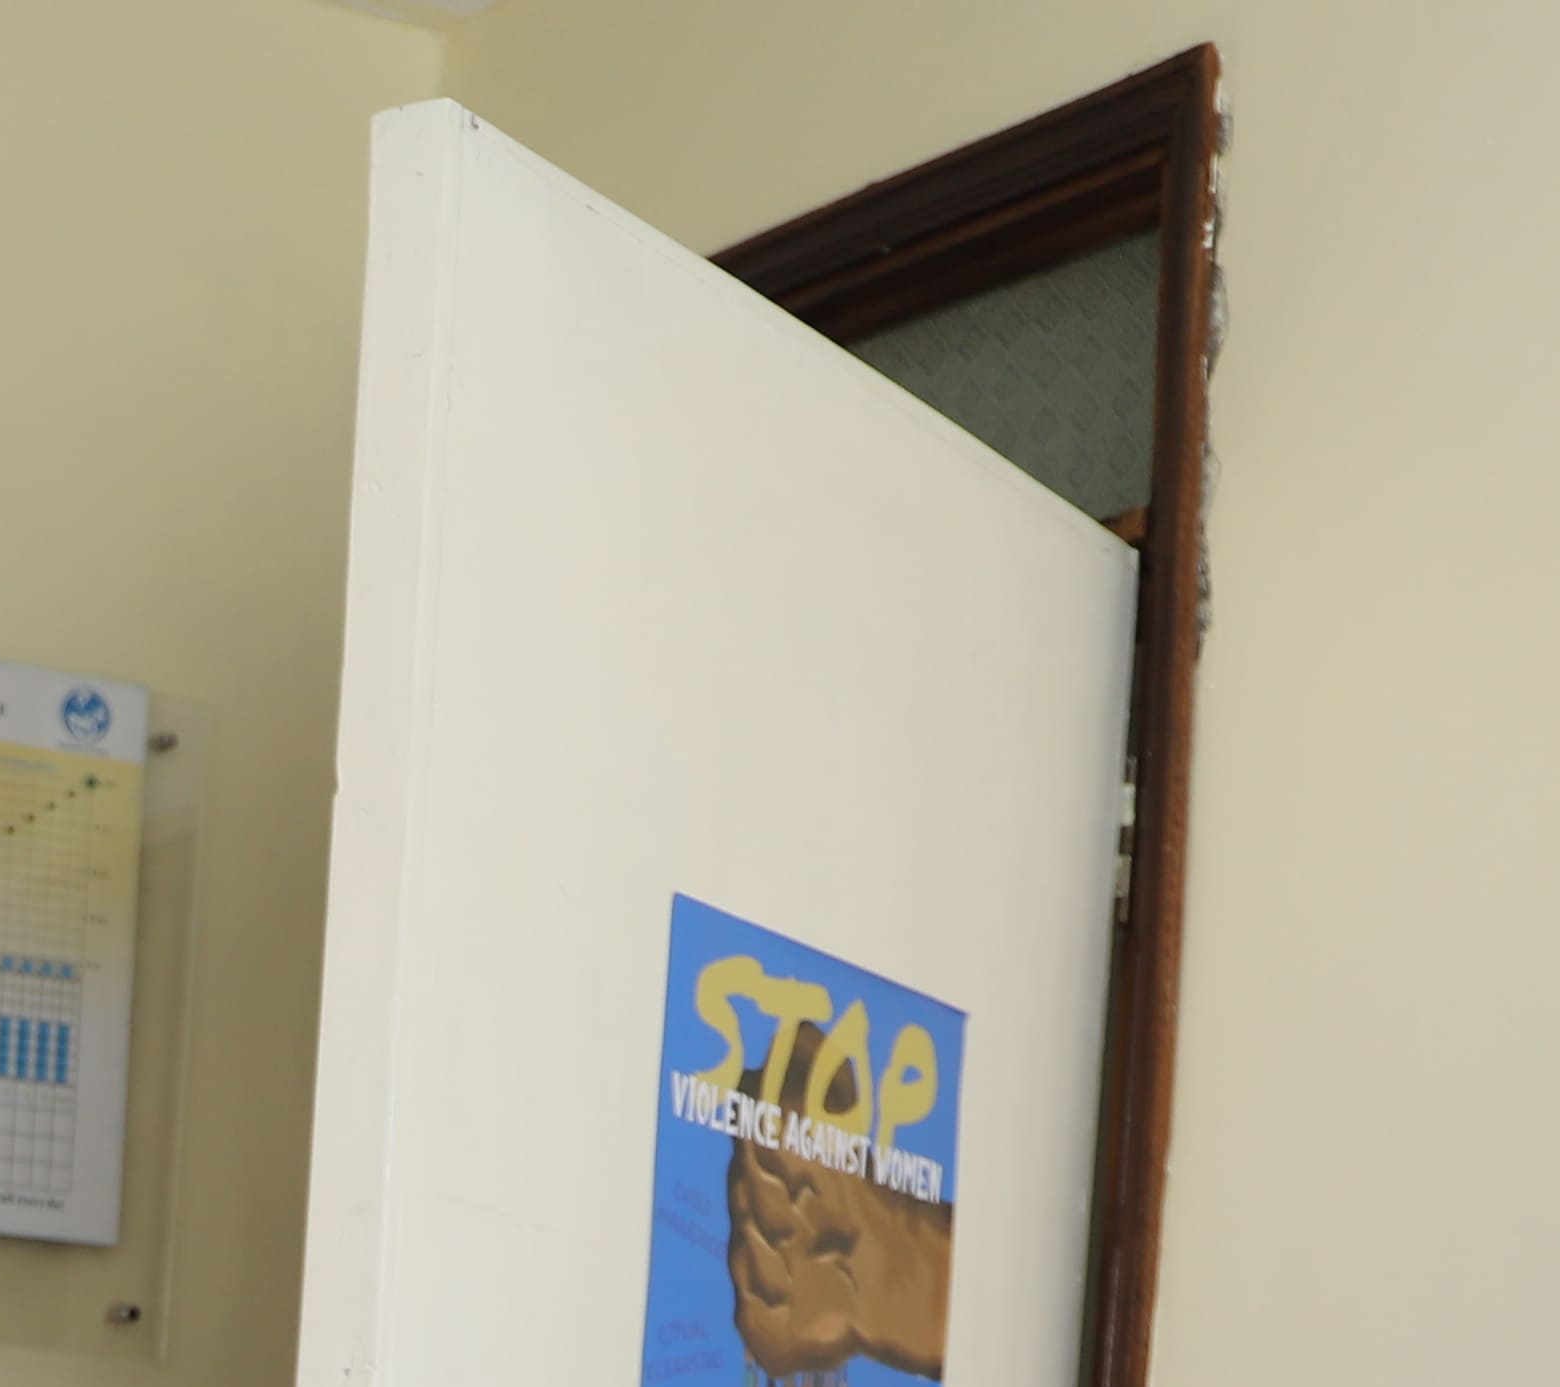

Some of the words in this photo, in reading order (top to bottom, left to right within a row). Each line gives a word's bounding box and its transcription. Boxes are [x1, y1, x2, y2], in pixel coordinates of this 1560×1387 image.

[695, 954, 939, 1150] STOP
[671, 1069, 782, 1150] VIOLENCE
[783, 1110, 871, 1181] AGAINST
[871, 1146, 944, 1206] WOMEN
